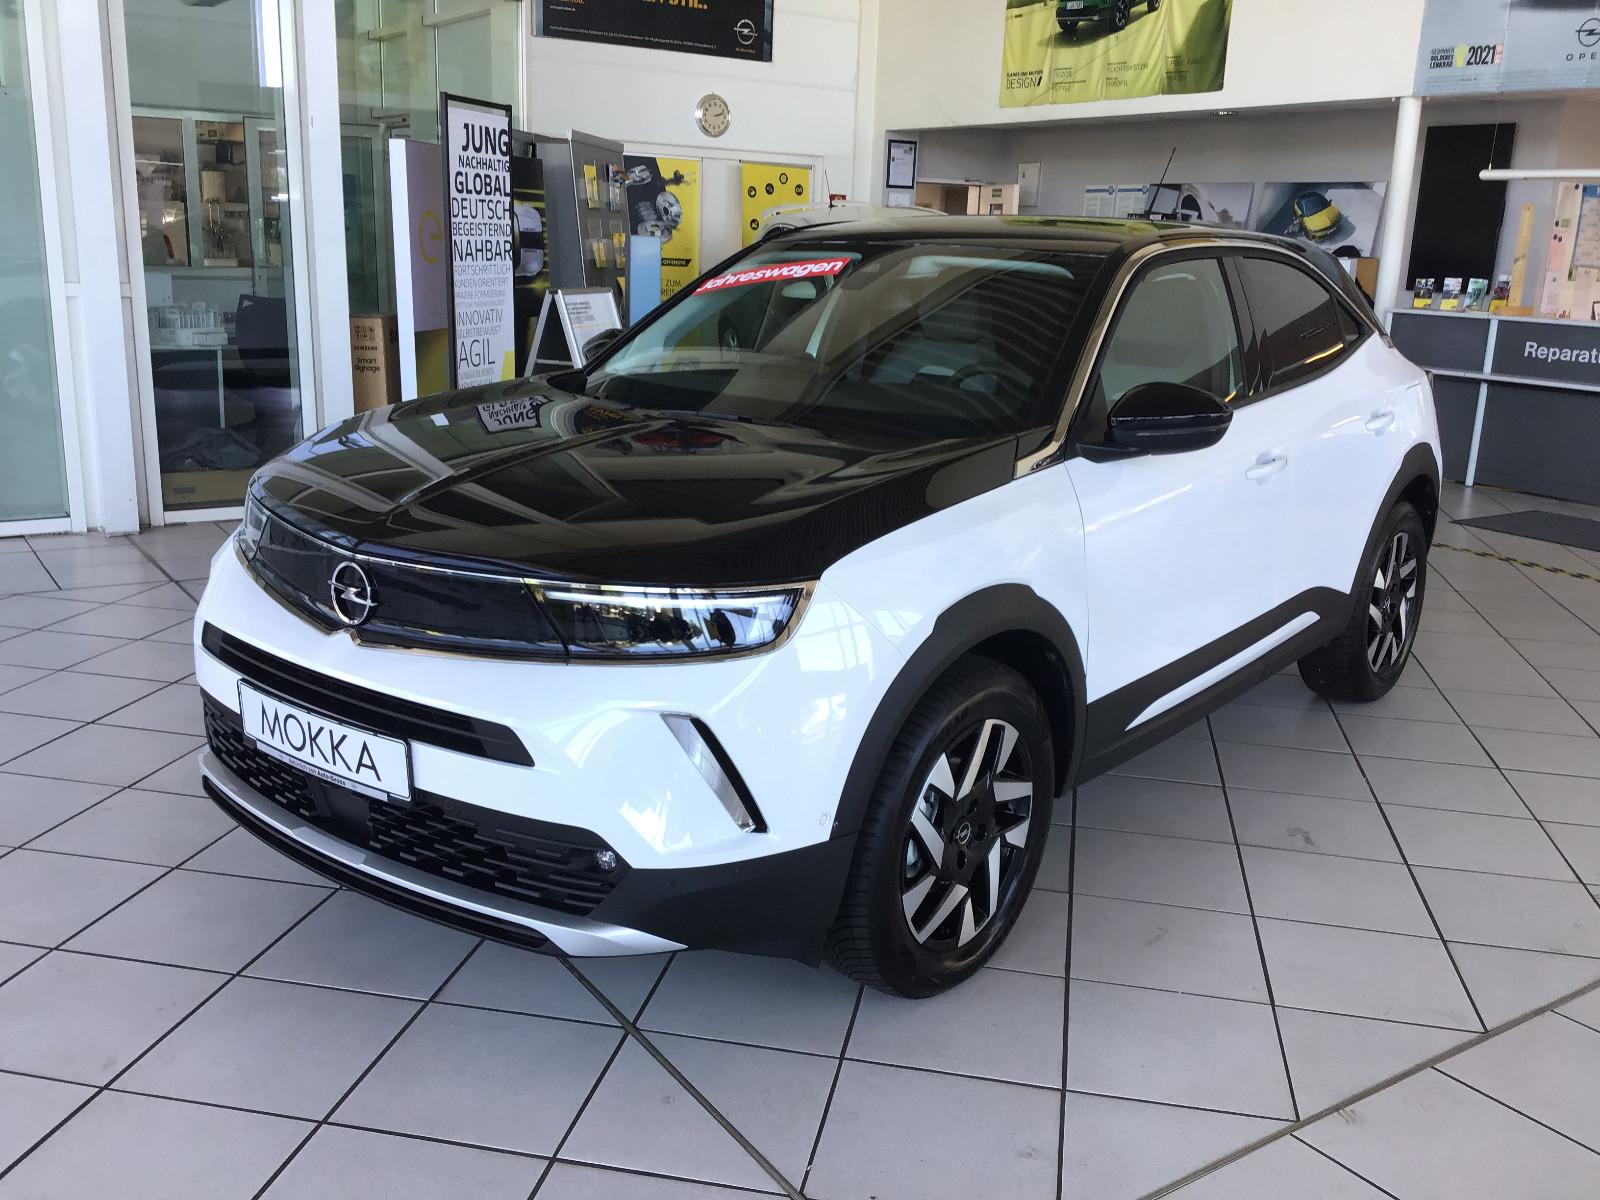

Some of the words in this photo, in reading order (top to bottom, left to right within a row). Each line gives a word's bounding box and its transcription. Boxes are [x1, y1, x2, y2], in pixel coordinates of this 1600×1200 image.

[1466, 44, 1497, 66] 2021
[462, 122, 509, 157] JUNG
[458, 154, 510, 173] NACHHALTIG
[454, 170, 511, 197] GLOBAL
[451, 197, 512, 220] DEUTSCH
[452, 221, 512, 237] BEGEISTERND
[453, 239, 513, 262] NAHBAR
[665, 279, 682, 288] ZUM
[457, 308, 503, 327] INNOVATIV
[356, 357, 377, 365] Smart
[458, 337, 496, 370] AGIL
[1524, 341, 1600, 364] Reparat
[354, 364, 381, 374] Signage
[261, 700, 382, 783] MOKKA
